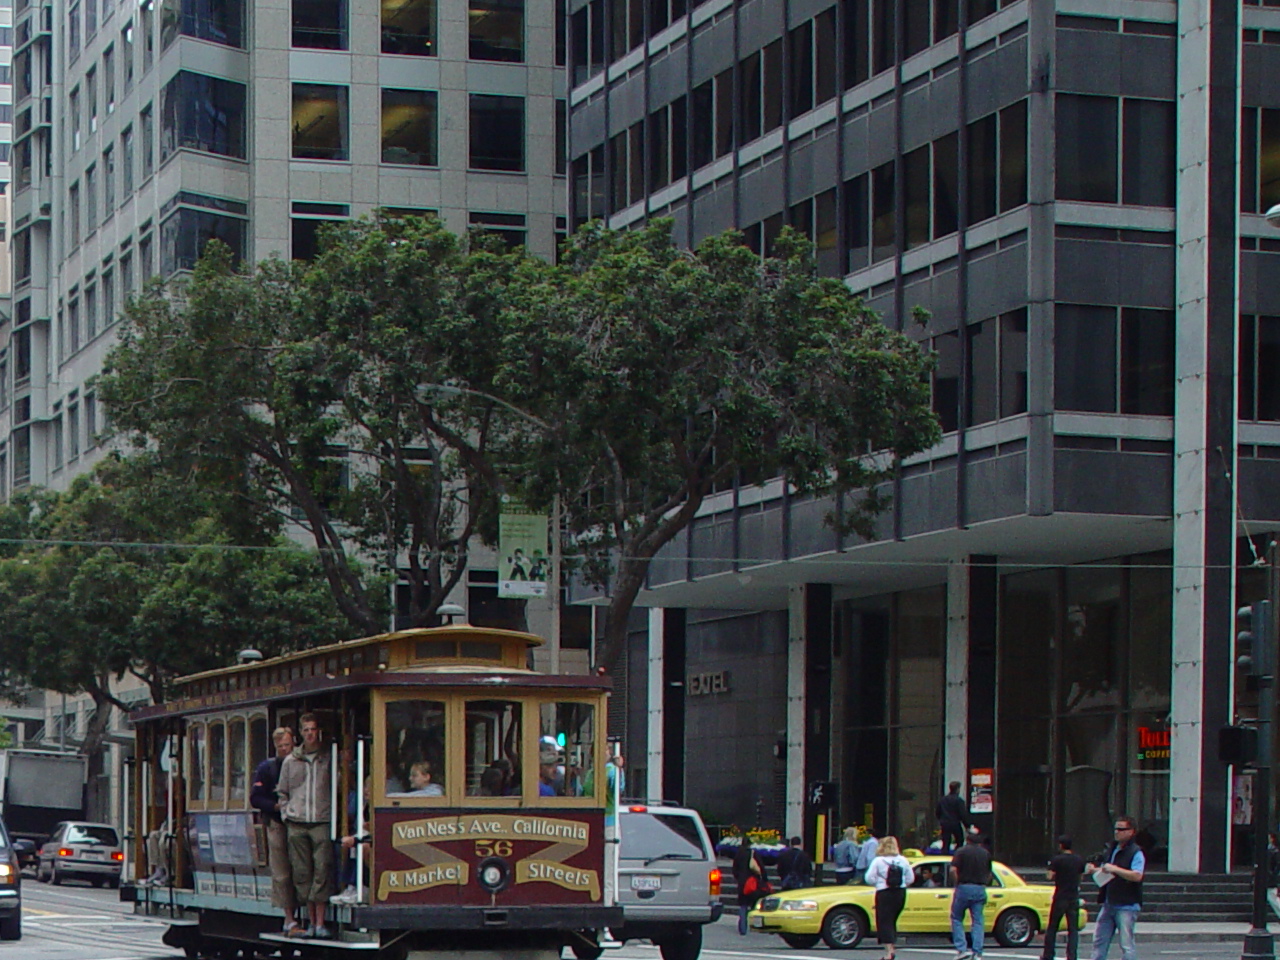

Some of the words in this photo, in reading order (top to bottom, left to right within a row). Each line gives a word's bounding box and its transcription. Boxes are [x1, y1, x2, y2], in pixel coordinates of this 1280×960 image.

[686, 671, 728, 696] EXTEL
[1137, 726, 1171, 749] TULL
[1145, 750, 1171, 759] COFFE
[397, 822, 426, 840] Van
[426, 820, 466, 837] Ness
[512, 818, 588, 840] California
[474, 839, 513, 858] 56
[388, 872, 401, 887] &
[404, 863, 462, 889] Market
[528, 862, 591, 886] Streets
